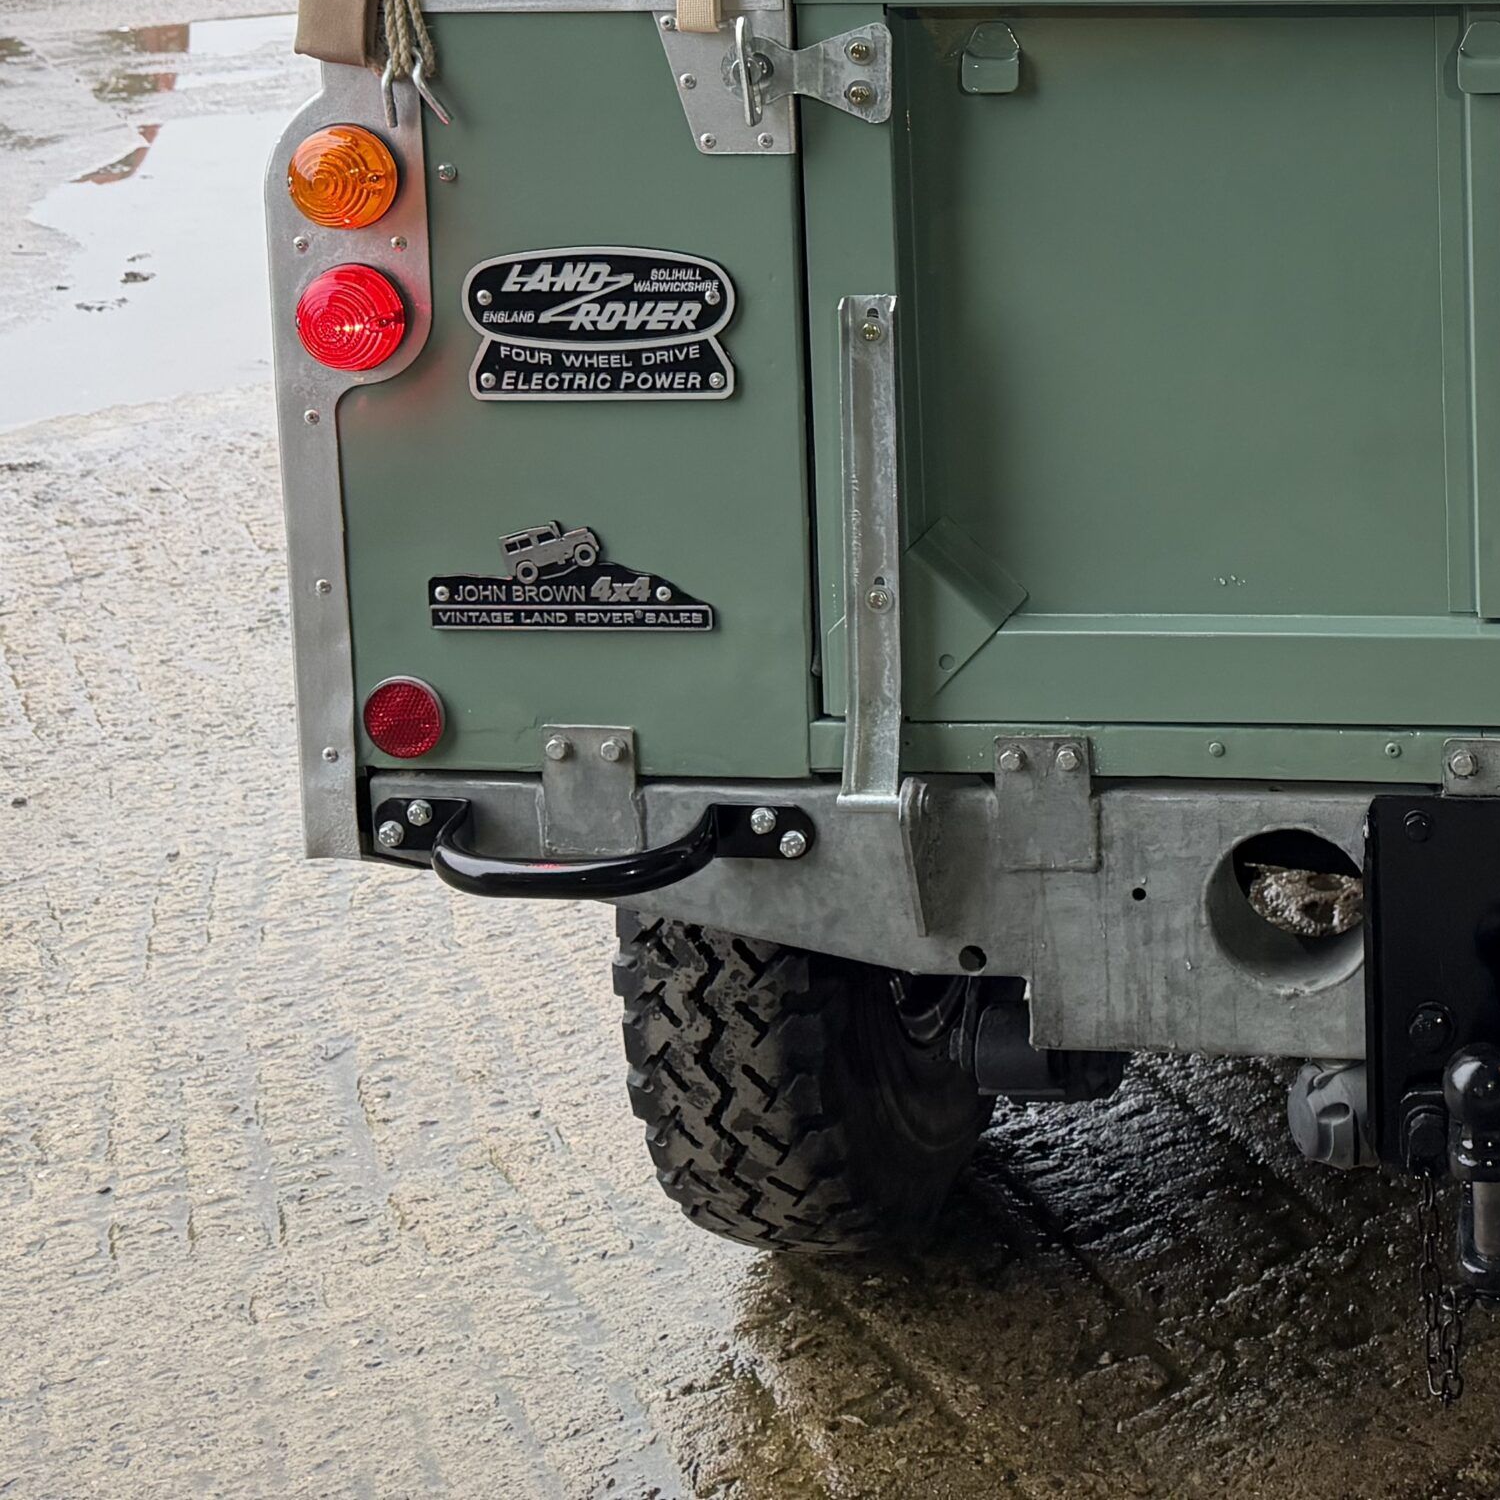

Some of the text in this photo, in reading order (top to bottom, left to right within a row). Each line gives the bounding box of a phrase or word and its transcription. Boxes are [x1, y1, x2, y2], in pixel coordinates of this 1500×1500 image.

[501, 262, 613, 292] LAND
[650, 268, 702, 280] SOLIHULL
[633, 280, 719, 293] WARWICKSHIRE
[482, 311, 535, 323] ENGLAND
[568, 300, 702, 331] ROVER
[500, 345, 701, 367] FOUR WHEEL DRIVE
[501, 371, 702, 390] ELECTRIC POWER
[454, 576, 651, 602] JOHN BROWN 4x4
[438, 611, 514, 624] VINTAGE
[520, 611, 568, 623] LAND
[644, 612, 704, 625] SALES
